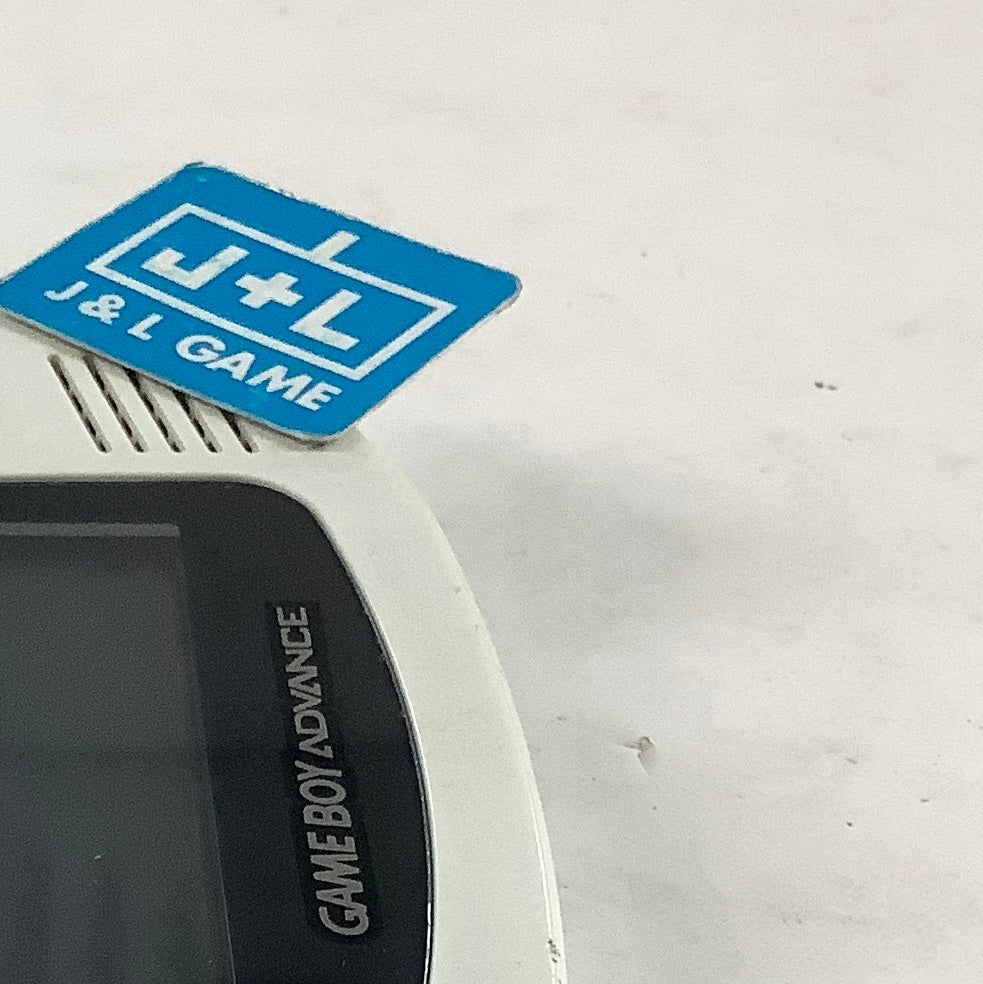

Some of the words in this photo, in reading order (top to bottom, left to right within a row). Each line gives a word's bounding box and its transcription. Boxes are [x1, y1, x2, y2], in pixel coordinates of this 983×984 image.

[44, 280, 89, 302] J
[127, 313, 164, 341] L
[175, 334, 343, 411] GAME
[276, 605, 335, 760] ADVANCE
[294, 760, 352, 828] BOY
[306, 831, 370, 936] GAME
